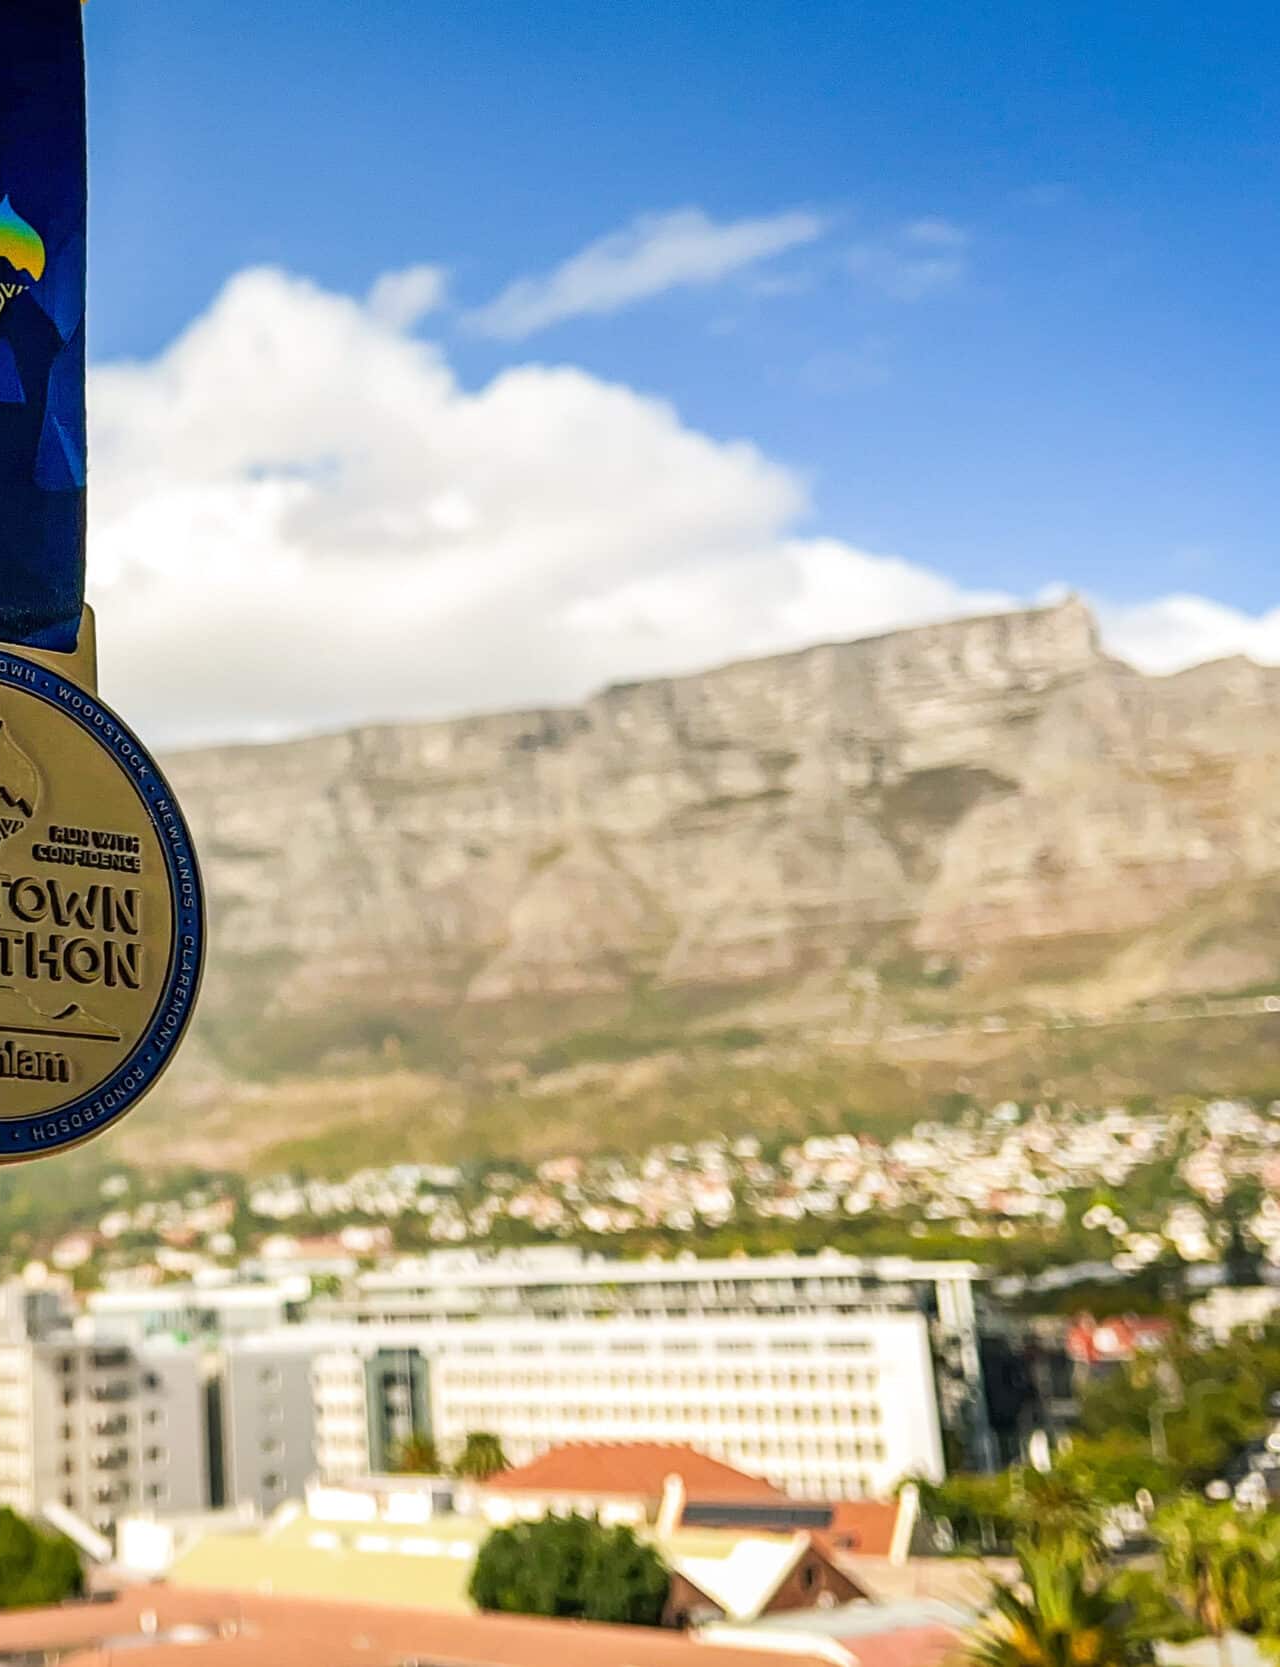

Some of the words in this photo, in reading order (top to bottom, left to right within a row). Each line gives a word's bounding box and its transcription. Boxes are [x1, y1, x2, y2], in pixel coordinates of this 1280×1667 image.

[58, 686, 149, 779] WOODSTOCK
[32, 844, 142, 874] CONFIDENCE
[49, 825, 90, 847] RUN
[91, 831, 141, 853] WITH
[156, 799, 194, 908] NEWLANDS
[154, 935, 195, 1051] CLAREMONT
[32, 1066, 145, 1140] RONDEBOSCH
